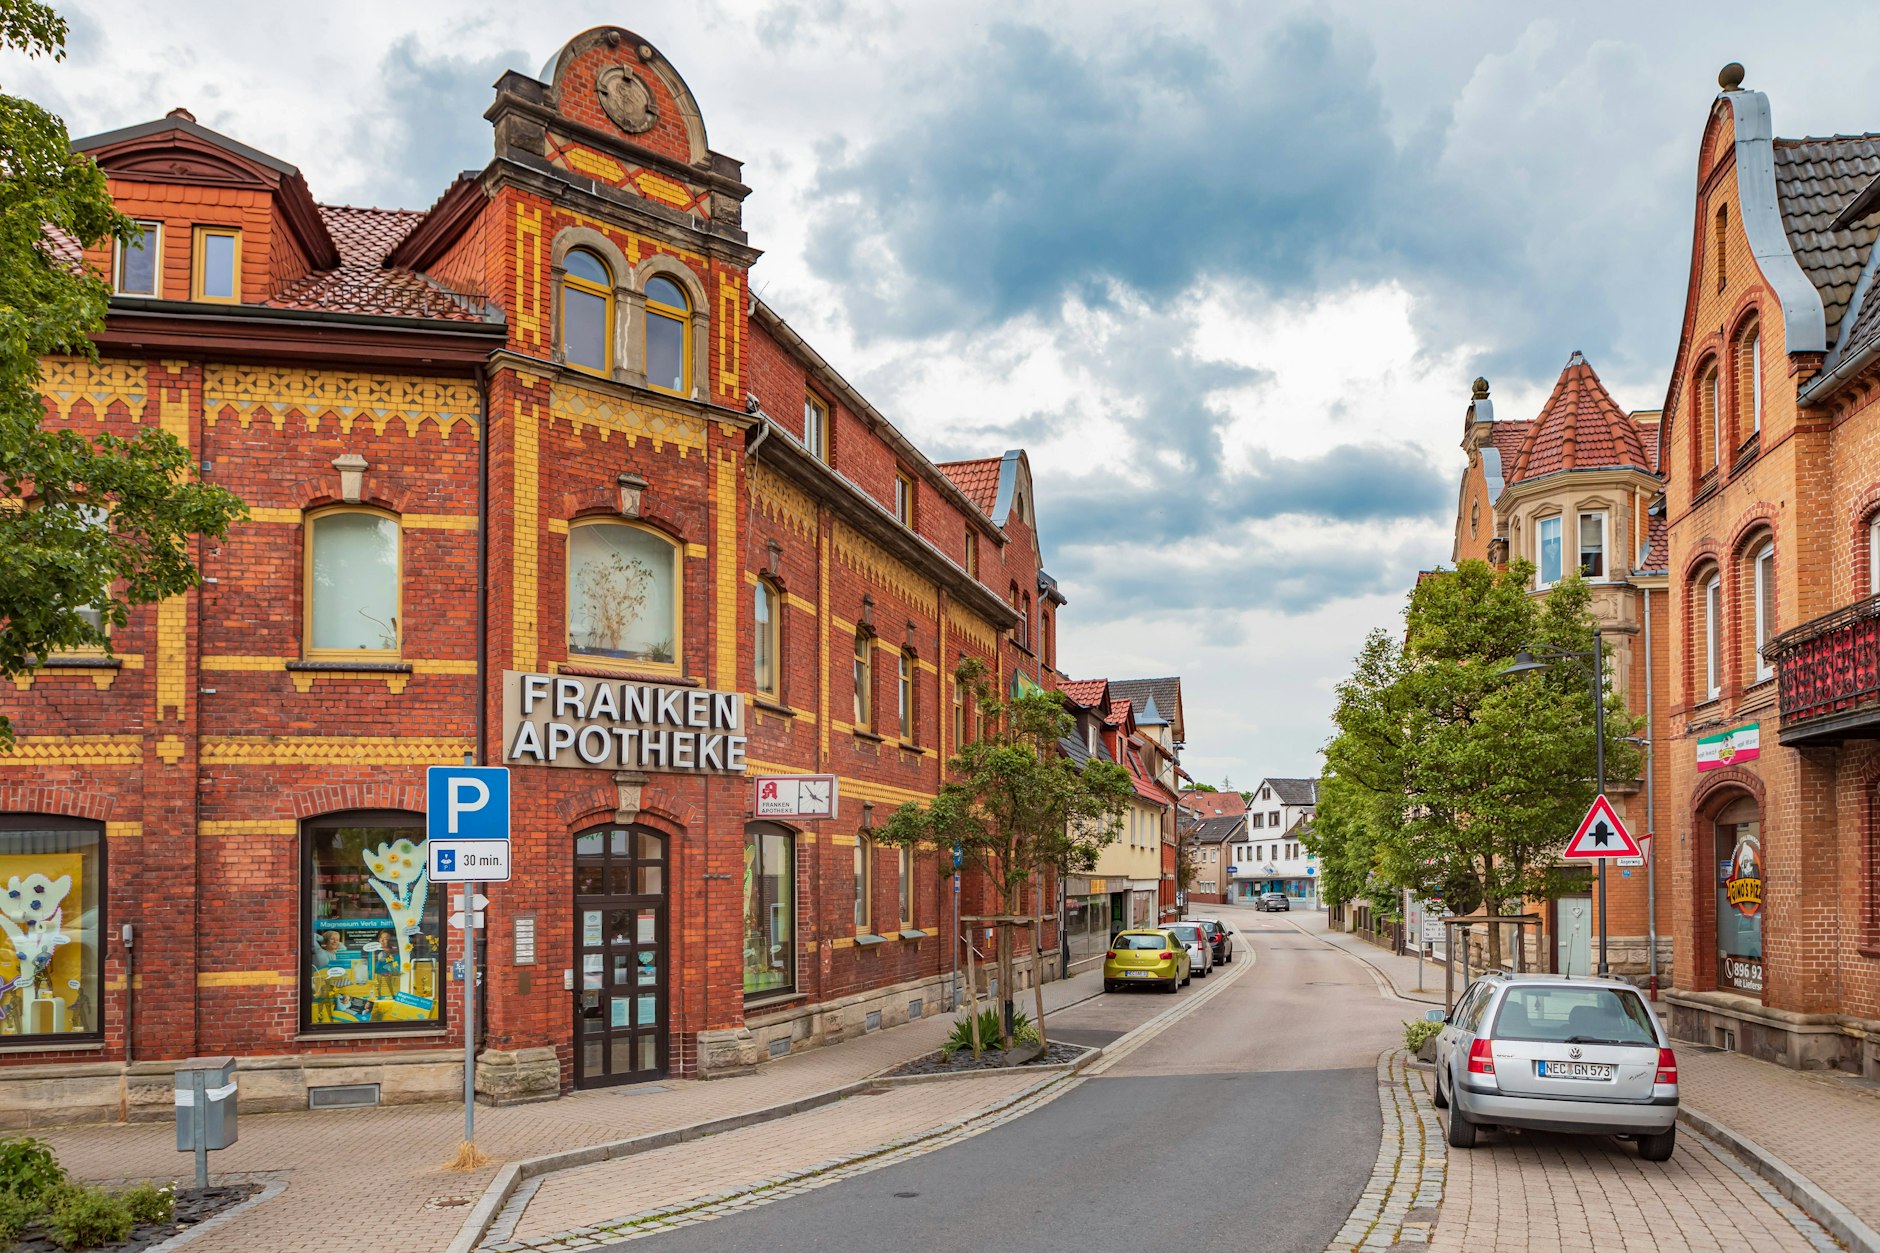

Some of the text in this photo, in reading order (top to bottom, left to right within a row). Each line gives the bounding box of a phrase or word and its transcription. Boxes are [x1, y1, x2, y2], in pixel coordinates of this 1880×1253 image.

[521, 674, 738, 730] FRANKEN
[508, 720, 748, 772] APOTHEKE
[447, 777, 490, 834] P
[463, 854, 503, 866] 30 min.
[1734, 962, 1762, 981] 896 92
[1734, 978, 1742, 987] Mit
[1546, 1063, 1610, 1077] NEC GN 573
